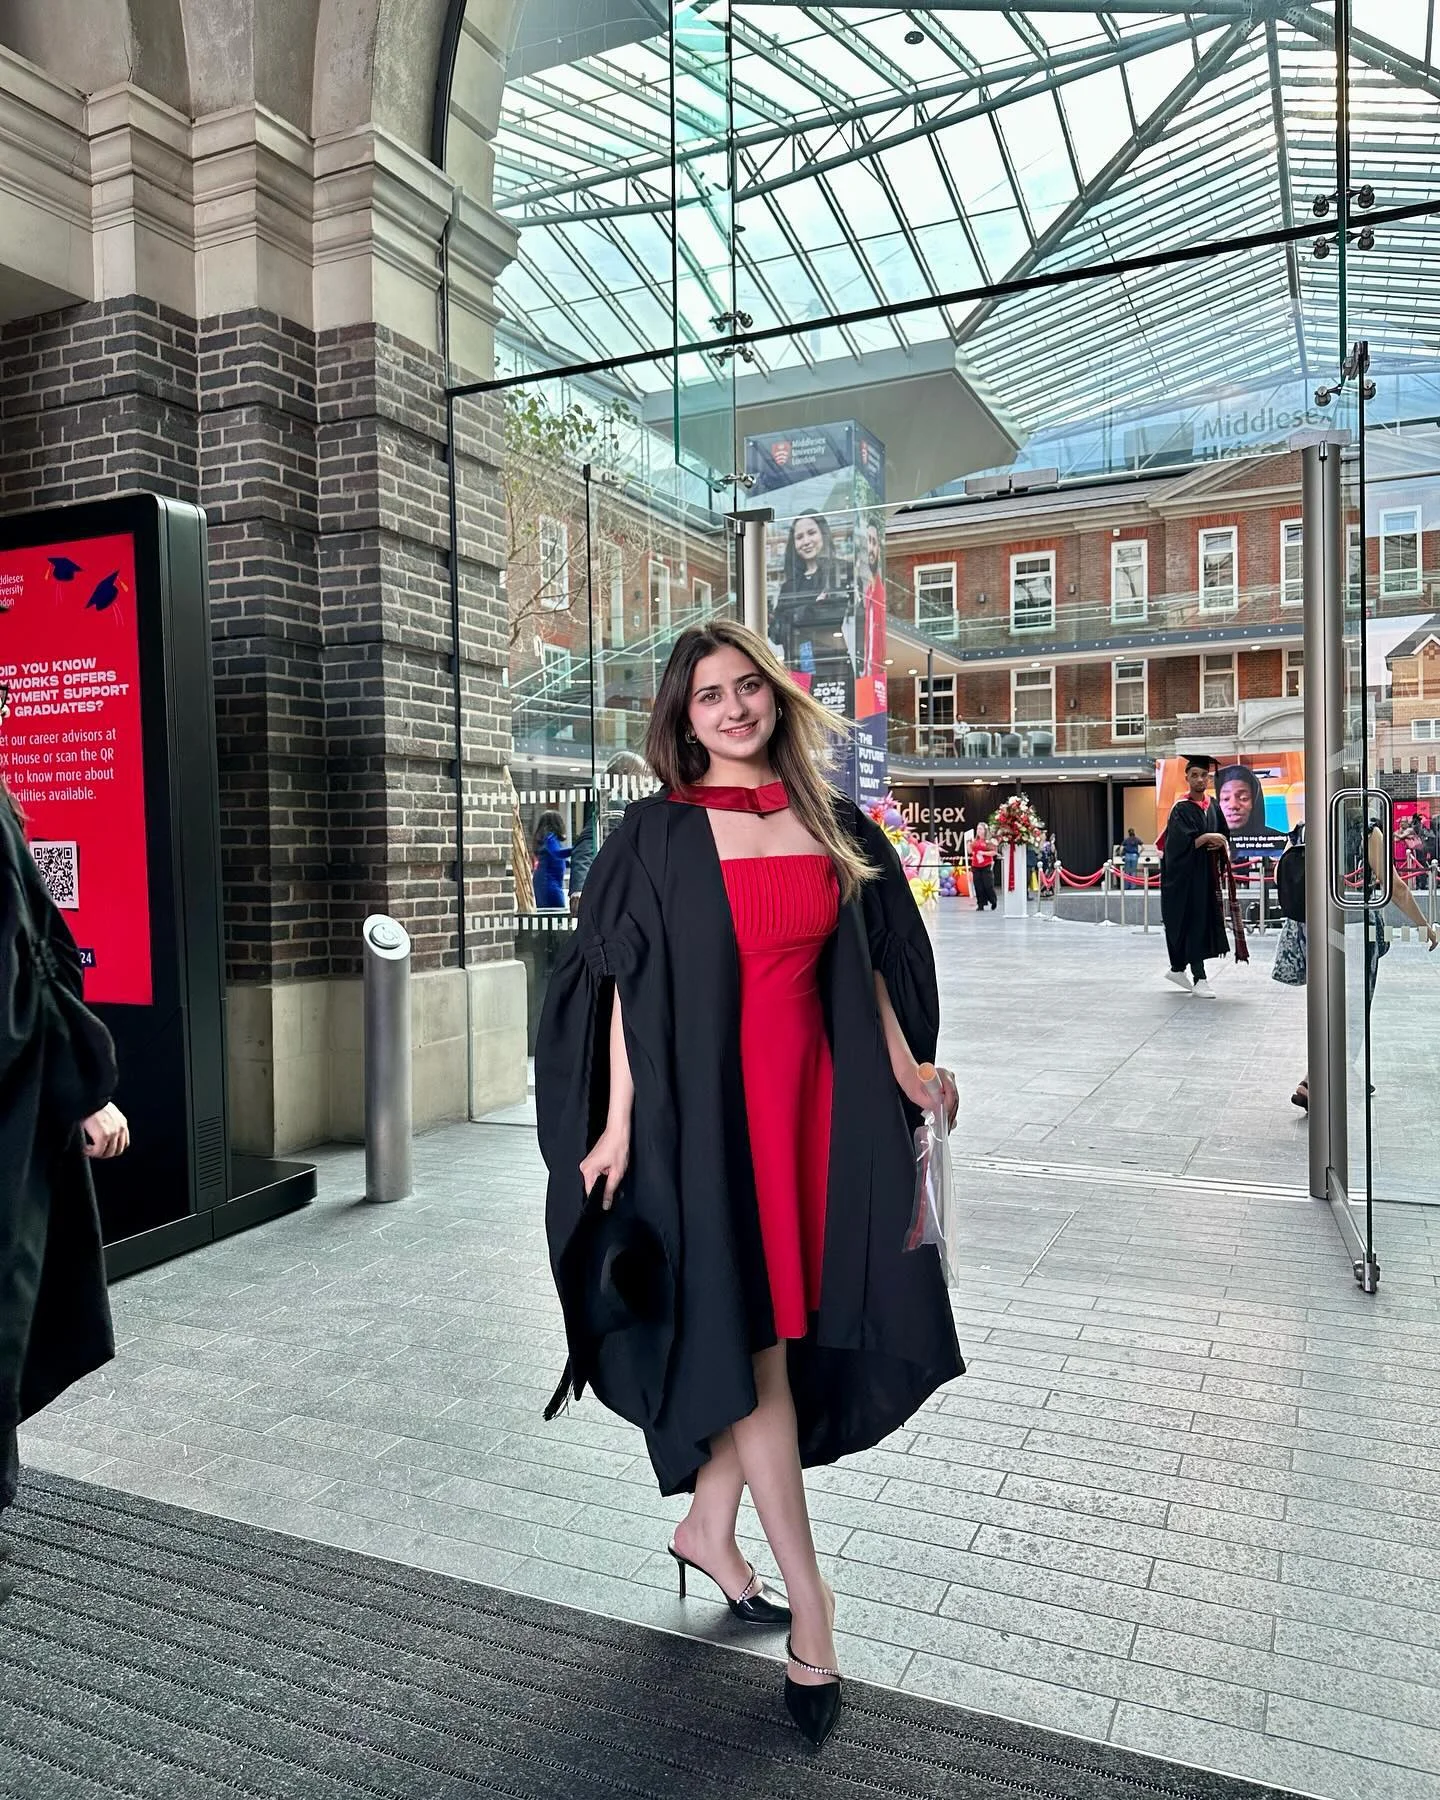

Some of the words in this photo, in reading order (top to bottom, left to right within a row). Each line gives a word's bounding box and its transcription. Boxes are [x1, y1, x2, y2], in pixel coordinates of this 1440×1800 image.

[21, 661, 48, 674] YOU
[52, 657, 97, 672] KNOW
[63, 670, 117, 685] OFFERS
[63, 683, 129, 699] SUPPORT
[813, 687, 846, 697] 20%
[822, 695, 846, 705] OFF
[15, 700, 104, 717] GRADUATES?
[11, 735, 26, 746] our
[29, 733, 59, 745] career
[62, 728, 103, 743] advisors
[106, 727, 116, 741] at
[858, 732, 873, 746] THE
[12, 752, 40, 765] House
[43, 752, 53, 764] or
[56, 751, 77, 763] scan
[80, 747, 97, 761] the
[100, 747, 114, 763] QR
[858, 747, 885, 762] FUTURE
[14, 771, 24, 783] to
[26, 769, 53, 783] know
[56, 770, 82, 782] more
[85, 766, 114, 781] about
[859, 762, 874, 775] YOU
[860, 776, 880, 790] WANT
[49, 786, 97, 801] available.
[80, 951, 92, 964] 24
